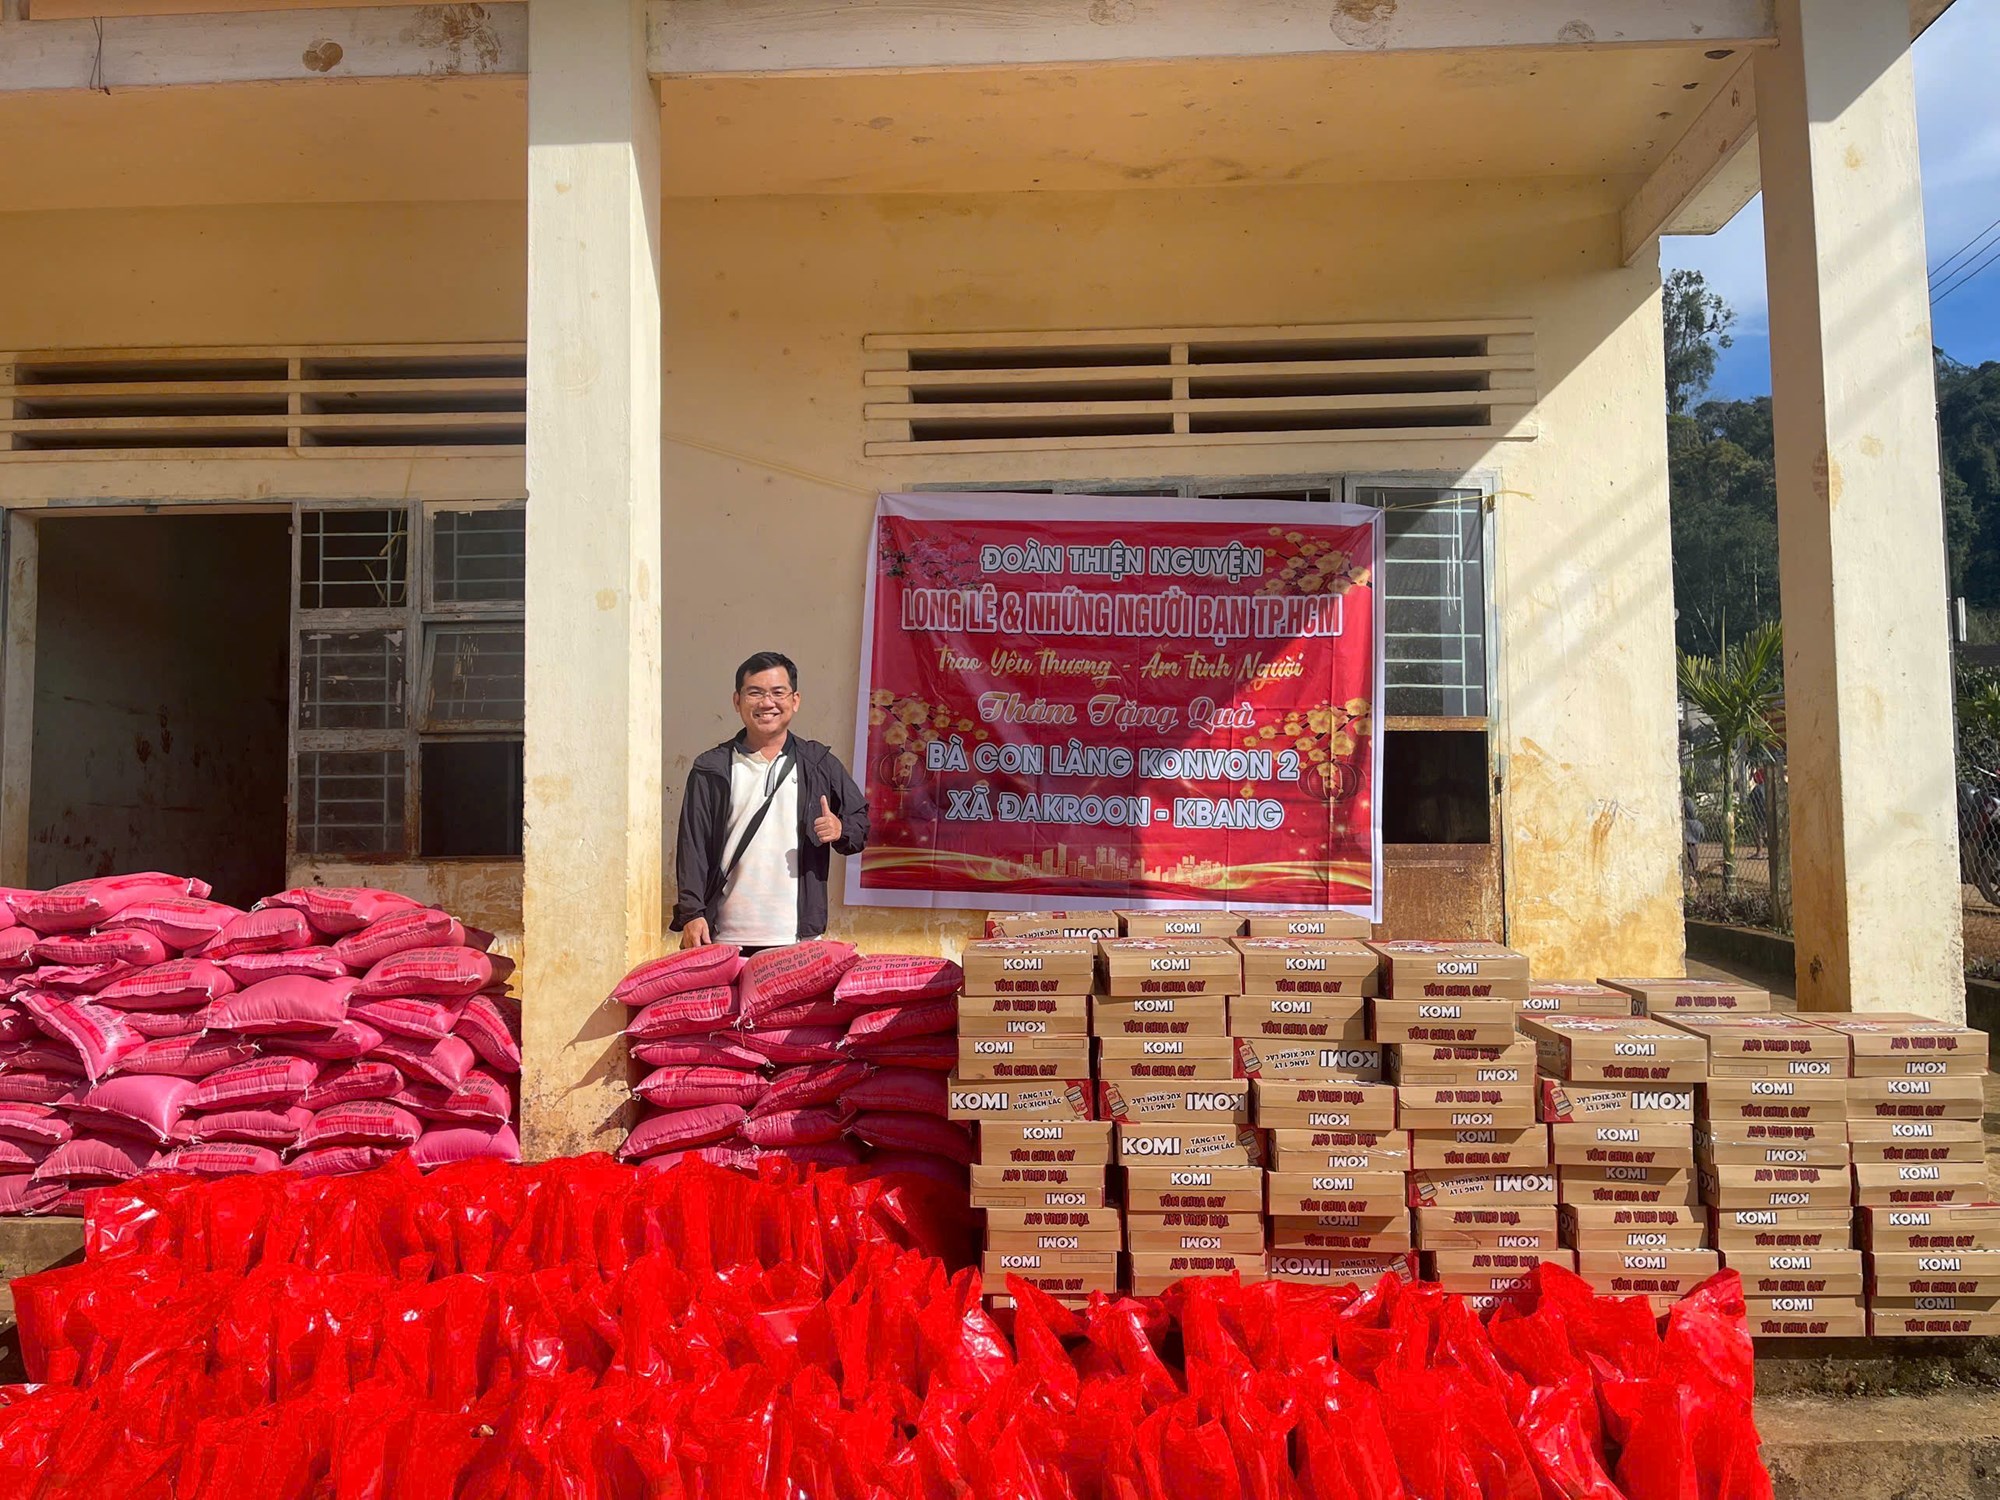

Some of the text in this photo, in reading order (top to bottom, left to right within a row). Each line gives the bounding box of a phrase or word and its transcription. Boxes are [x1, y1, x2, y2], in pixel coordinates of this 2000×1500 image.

[981, 537, 1263, 583] ĐOÀN THIỆN NGUYỆN
[901, 583, 1343, 647] LONG LÊ & NHỮNG NGƯỜI BẠN TP.HCM
[934, 646, 982, 672] Trao
[990, 647, 1032, 676] Yêu
[1035, 648, 1121, 686] Thương
[1184, 650, 1231, 679] Tình
[1238, 652, 1304, 690] Người
[978, 691, 1256, 735] Thăm Tặng Quà
[926, 734, 1299, 780] BÀ CON LÀNG KONVON 2
[945, 785, 993, 821] XÃ
[998, 793, 1151, 825] ĐAKROON
[1174, 798, 1284, 829] KBANG
[1165, 923, 1201, 934] KOMI
[1288, 923, 1325, 934] KOMI
[1003, 958, 1043, 971] KOMI
[1151, 959, 1190, 971] KOMI
[1285, 958, 1326, 971] KOMI
[1436, 962, 1478, 975] KOMI
[1039, 980, 1058, 992] CAY
[1186, 980, 1206, 993] CAY
[1321, 981, 1342, 993] CAY
[1471, 984, 1492, 997] CAY
[1134, 1001, 1174, 1012] KOMI
[1271, 1001, 1311, 1014] KOMI
[1523, 998, 1560, 1010] KOMI
[1419, 1005, 1461, 1018] KOMI
[1007, 1021, 1046, 1033] KOMI
[1308, 1023, 1328, 1035] CAY
[974, 1041, 1014, 1054] KOMI
[1143, 1042, 1183, 1054] KOMI
[1614, 1043, 1656, 1056] KOMI
[1318, 1050, 1378, 1069] KOMI
[1037, 1064, 1057, 1076] CAY
[1651, 1067, 1670, 1079] CAY
[1788, 1062, 1831, 1074] KOMI
[1905, 1062, 1947, 1074] KOMI
[1477, 1069, 1518, 1082] KOMI
[1752, 1082, 1794, 1094] KOMI
[1888, 1081, 1930, 1093] KOMI
[951, 1092, 1008, 1110] KOMI
[1186, 1092, 1245, 1111] KOMI
[1631, 1092, 1690, 1110] KOMI
[1926, 1104, 1945, 1116] CAY
[1309, 1113, 1349, 1126] KOMI
[1452, 1113, 1492, 1125] KOMI
[1023, 1127, 1063, 1140] KOMI
[1596, 1128, 1639, 1142] KOMI
[1892, 1124, 1933, 1137] KOMI
[1456, 1131, 1496, 1143] KOMI
[1122, 1137, 1181, 1156] KOMI
[1057, 1150, 1075, 1162] CAY
[1328, 1156, 1368, 1168] KOMI
[1492, 1152, 1510, 1164] CAY
[1765, 1150, 1807, 1162] KOMI
[1606, 1167, 1646, 1179] KOMI
[1899, 1167, 1939, 1179] KOMI
[1170, 1173, 1211, 1186] KOMI
[1312, 1177, 1354, 1191] KOMI
[1494, 1174, 1553, 1193] KOMI
[1045, 1194, 1086, 1205] KOMI
[1206, 1196, 1226, 1208] CAY
[1769, 1193, 1810, 1204] KOMI
[1318, 1216, 1360, 1226] KOMI
[1735, 1212, 1777, 1224] KOMI
[1889, 1214, 1931, 1225] KOMI
[1038, 1237, 1078, 1248] KOMI
[1180, 1237, 1221, 1249] KOMI
[1351, 1236, 1371, 1249] CAY
[1499, 1236, 1539, 1248] KOMI
[1627, 1234, 1667, 1246] KOMI
[1000, 1255, 1040, 1268] KOMI
[1271, 1256, 1330, 1276] KOMI
[1624, 1256, 1666, 1268] KOMI
[1769, 1257, 1811, 1269] KOMI
[1918, 1259, 1961, 1271] KOMI
[1490, 1278, 1532, 1289] KOMI
[1660, 1280, 1680, 1292] CAY
[1771, 1298, 1813, 1311] KOMI
[1914, 1297, 1955, 1310] KOMI
[1953, 1320, 1971, 1332] CAY
